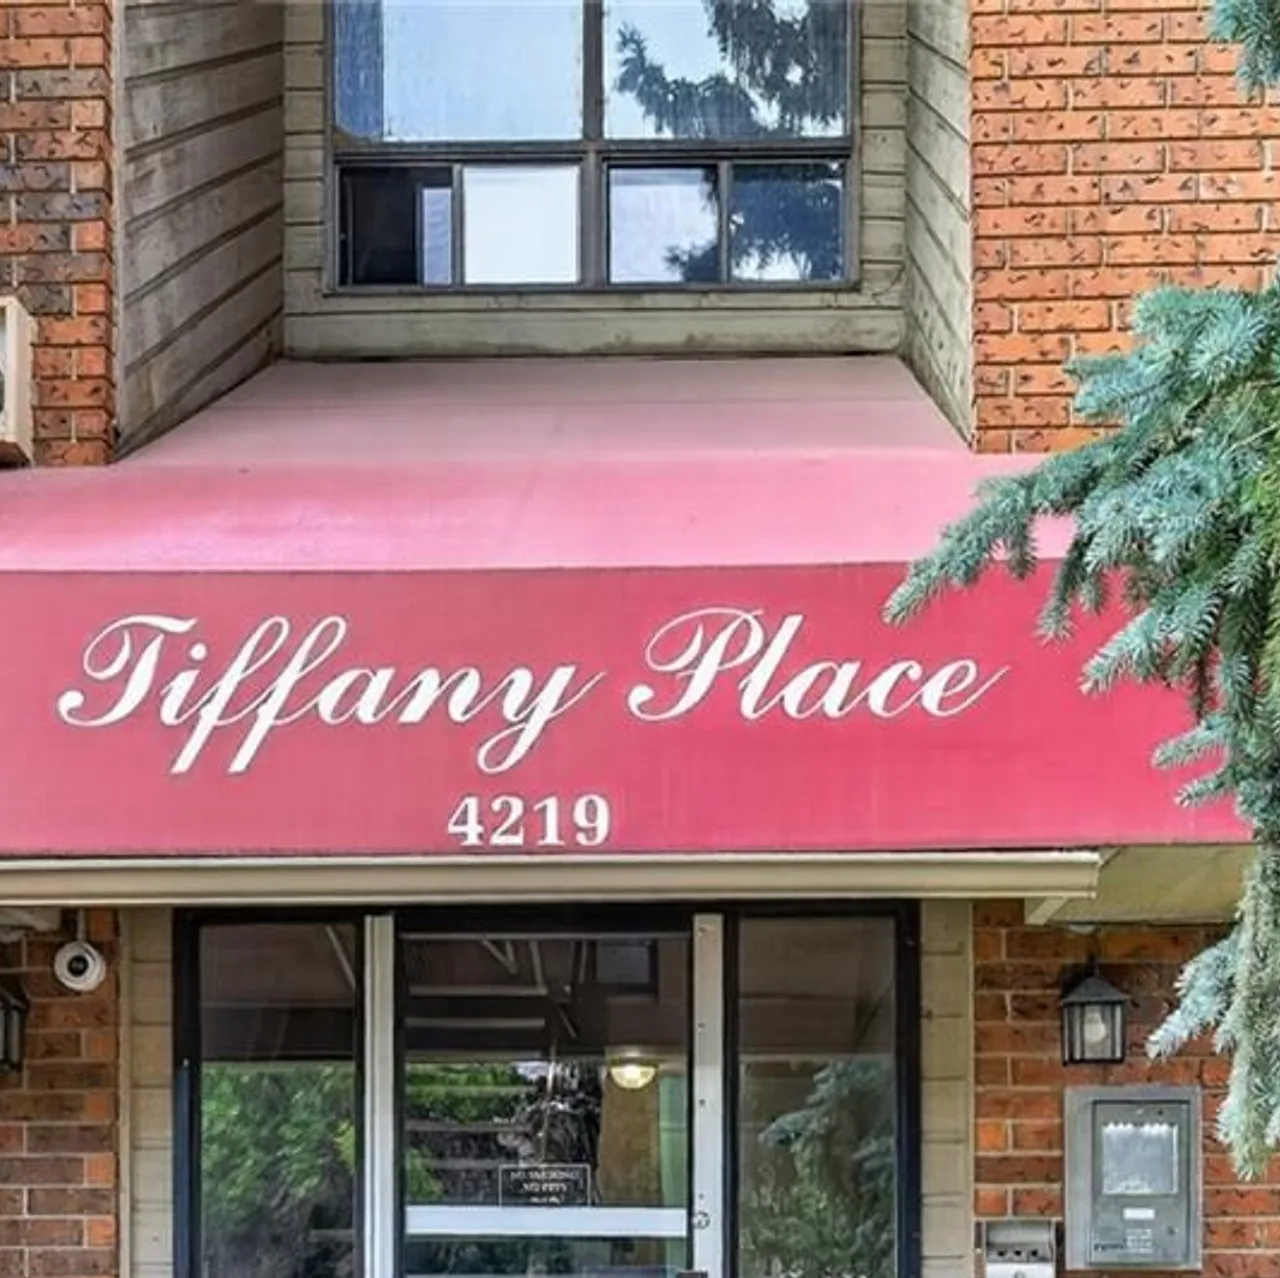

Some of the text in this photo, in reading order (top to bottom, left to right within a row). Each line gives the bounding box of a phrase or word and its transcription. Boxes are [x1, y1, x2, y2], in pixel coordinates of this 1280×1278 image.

[56, 606, 1008, 775] Tiffany Place
[446, 793, 612, 848] 4219
